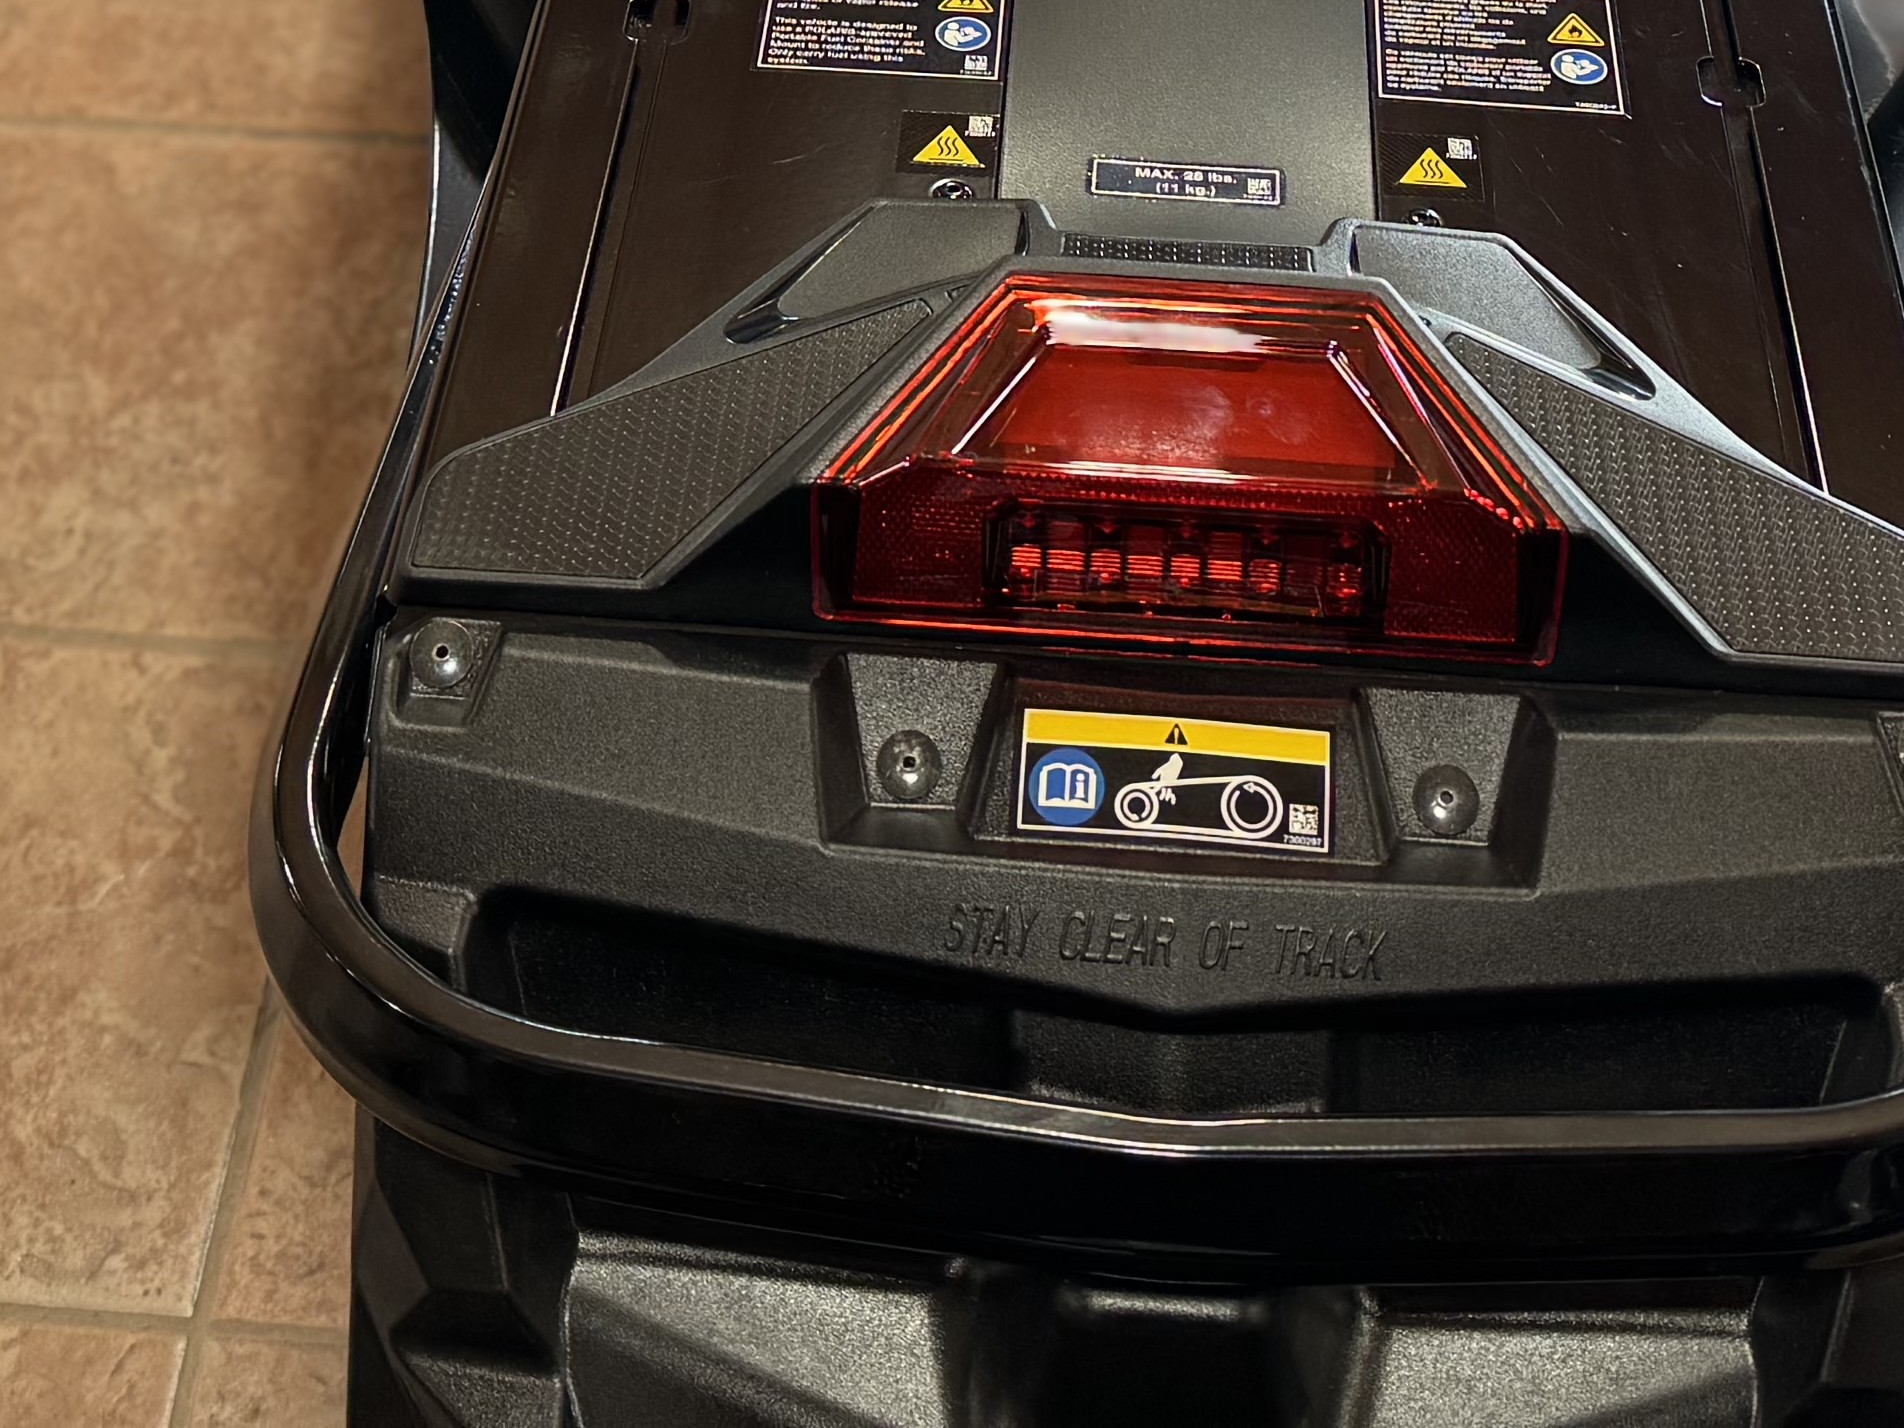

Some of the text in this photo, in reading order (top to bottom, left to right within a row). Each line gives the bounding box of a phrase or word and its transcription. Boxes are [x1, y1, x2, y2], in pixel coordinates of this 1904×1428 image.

[1135, 167, 1179, 180] MAX.
[1208, 172, 1238, 184] lbs.
[946, 902, 1389, 981] STAY CLEAR OF TRACK
